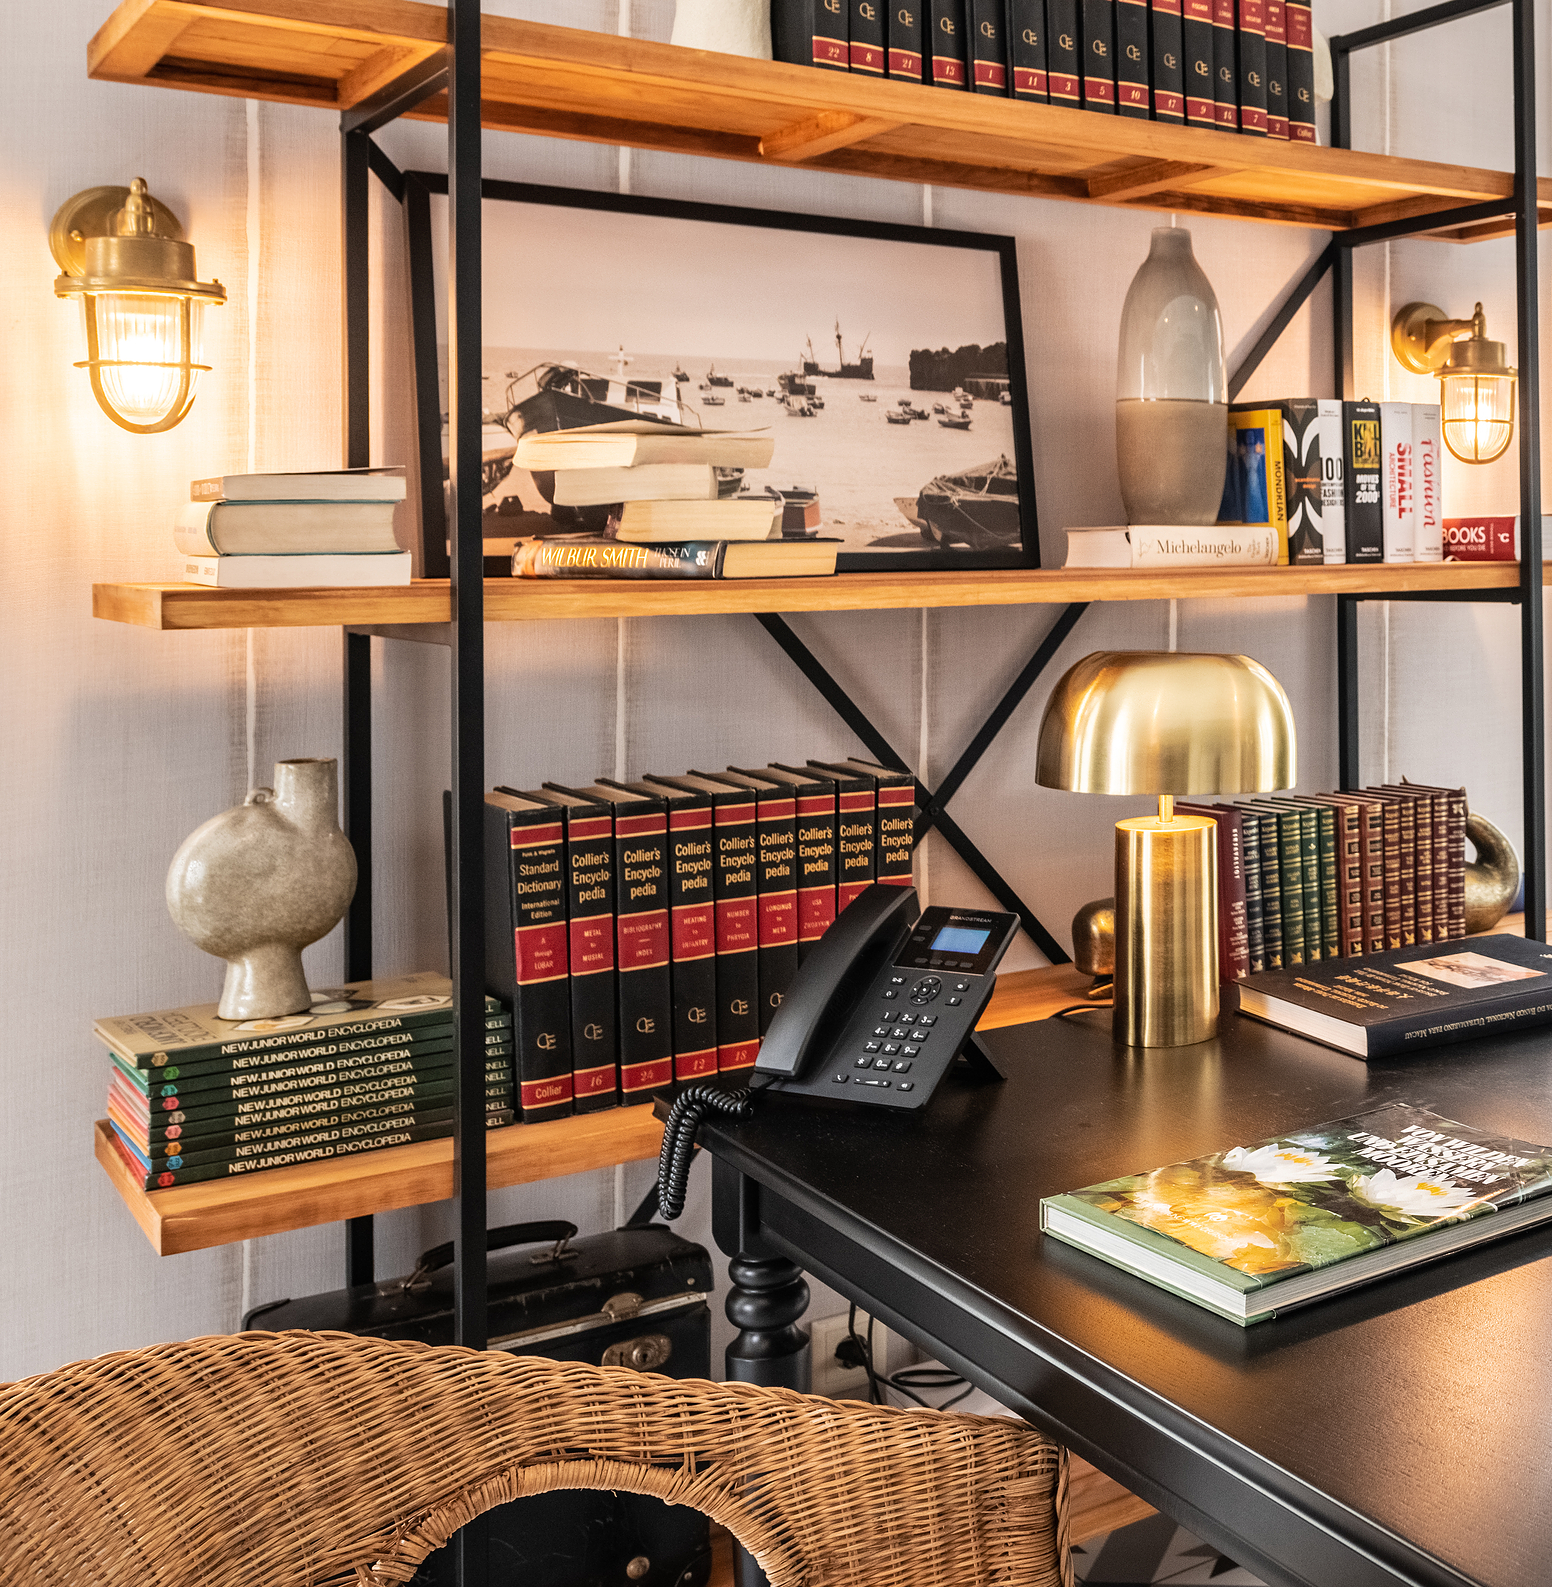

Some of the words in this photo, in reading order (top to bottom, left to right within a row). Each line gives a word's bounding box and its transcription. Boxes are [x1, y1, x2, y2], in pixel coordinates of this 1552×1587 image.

[828, 46, 840, 58] 22
[865, 52, 872, 62] 8
[902, 58, 912, 69] 21
[945, 66, 955, 76] 13
[1028, 76, 1038, 87] 11
[1131, 90, 1140, 100] 10
[1168, 99, 1177, 109] 17
[1320, 457, 1343, 481] 100
[1356, 474, 1379, 484] MOVIES
[1389, 452, 1397, 508] ARCHITECTURE
[1397, 442, 1413, 519] SMALL
[1275, 461, 1284, 521] MONDRIAN
[1442, 526, 1486, 544] BOOKS
[1157, 539, 1242, 558] Michelangelo
[542, 547, 598, 567] WILBUR
[601, 547, 649, 568] SMITH
[659, 558, 681, 568] PERIL
[840, 823, 873, 838] Collier's
[881, 818, 913, 832] Collier's
[760, 831, 794, 846] Collier's
[799, 826, 833, 841] Collier's
[675, 841, 711, 857] Collier's
[719, 836, 755, 851] Collier's
[572, 851, 609, 868] Collier's
[624, 848, 661, 864] Collier's
[845, 855, 869, 870] pedia
[886, 849, 909, 863] pedia
[519, 860, 559, 876] Standard
[766, 865, 790, 880] pedia
[804, 860, 829, 875] pedia
[682, 876, 708, 892] pedia
[726, 870, 751, 886] pedia
[517, 880, 562, 894] Dictionary
[579, 886, 606, 903] pedia
[630, 882, 656, 900] pedia
[521, 898, 560, 910] International
[766, 903, 792, 912] LONGINUS
[531, 911, 552, 919] Edition
[683, 915, 707, 925] HEATING
[727, 909, 750, 918] NUMBER
[950, 914, 993, 923] GRANDSTREAM
[584, 929, 602, 937] METAL
[623, 922, 662, 934] BIBLIOGRAPHY
[727, 933, 750, 942] PHRYGIA
[636, 949, 653, 957] INDEX
[1486, 1010, 1515, 1023] NACIONAL
[1515, 1006, 1536, 1018] BANCO
[1428, 1024, 1443, 1033] PARA
[1443, 1017, 1485, 1031] ULTRAMARINO
[221, 1042, 249, 1054] NEW
[249, 1036, 286, 1050] JUNIOR
[287, 1030, 325, 1044] WORLD
[328, 1018, 402, 1037] ENCYCLOPEDIA
[1404, 1028, 1428, 1040] MACAU
[232, 1056, 260, 1069] NEW
[260, 1050, 298, 1064] JUNIOR
[298, 1045, 337, 1058] WORLD
[339, 1033, 413, 1052] ENCYCLOPEDIA
[735, 1050, 747, 1061] 18
[230, 1073, 258, 1086] NEW
[258, 1068, 295, 1081] JUNIOR
[296, 1062, 335, 1075] WORLD
[337, 1049, 411, 1069] ENCYCLOPEDIA
[232, 1086, 260, 1099] NEW
[260, 1080, 298, 1094] JUNIOR
[298, 1074, 336, 1088] WORLD
[339, 1061, 413, 1081] ENCYCLOPEDIA
[590, 1076, 603, 1087] 16
[238, 1100, 265, 1113] NEW
[265, 1095, 303, 1109] JUNIOR
[303, 1088, 341, 1102] WORLD
[343, 1075, 417, 1095] ENCYCLOPEDIA
[535, 1084, 562, 1099] Collier
[236, 1143, 264, 1157] NEW
[264, 1137, 301, 1151] JUNIOR
[301, 1130, 340, 1145] WORLD
[342, 1117, 415, 1137] ENCYCLOPEDIA
[229, 1160, 257, 1173] NEW
[257, 1154, 294, 1168] JUNIOR
[295, 1147, 334, 1161] WORLD
[336, 1133, 411, 1154] ENCYCLOPEDIA
[1395, 1135, 1504, 1171] WASSERN
[1400, 1124, 1451, 1143] VON
[1442, 1137, 1536, 1168] WILDEN
[1347, 1132, 1397, 1150] UND
[1398, 1146, 1506, 1184] EINSAMEN
[1352, 1147, 1456, 1183] MOOREN
